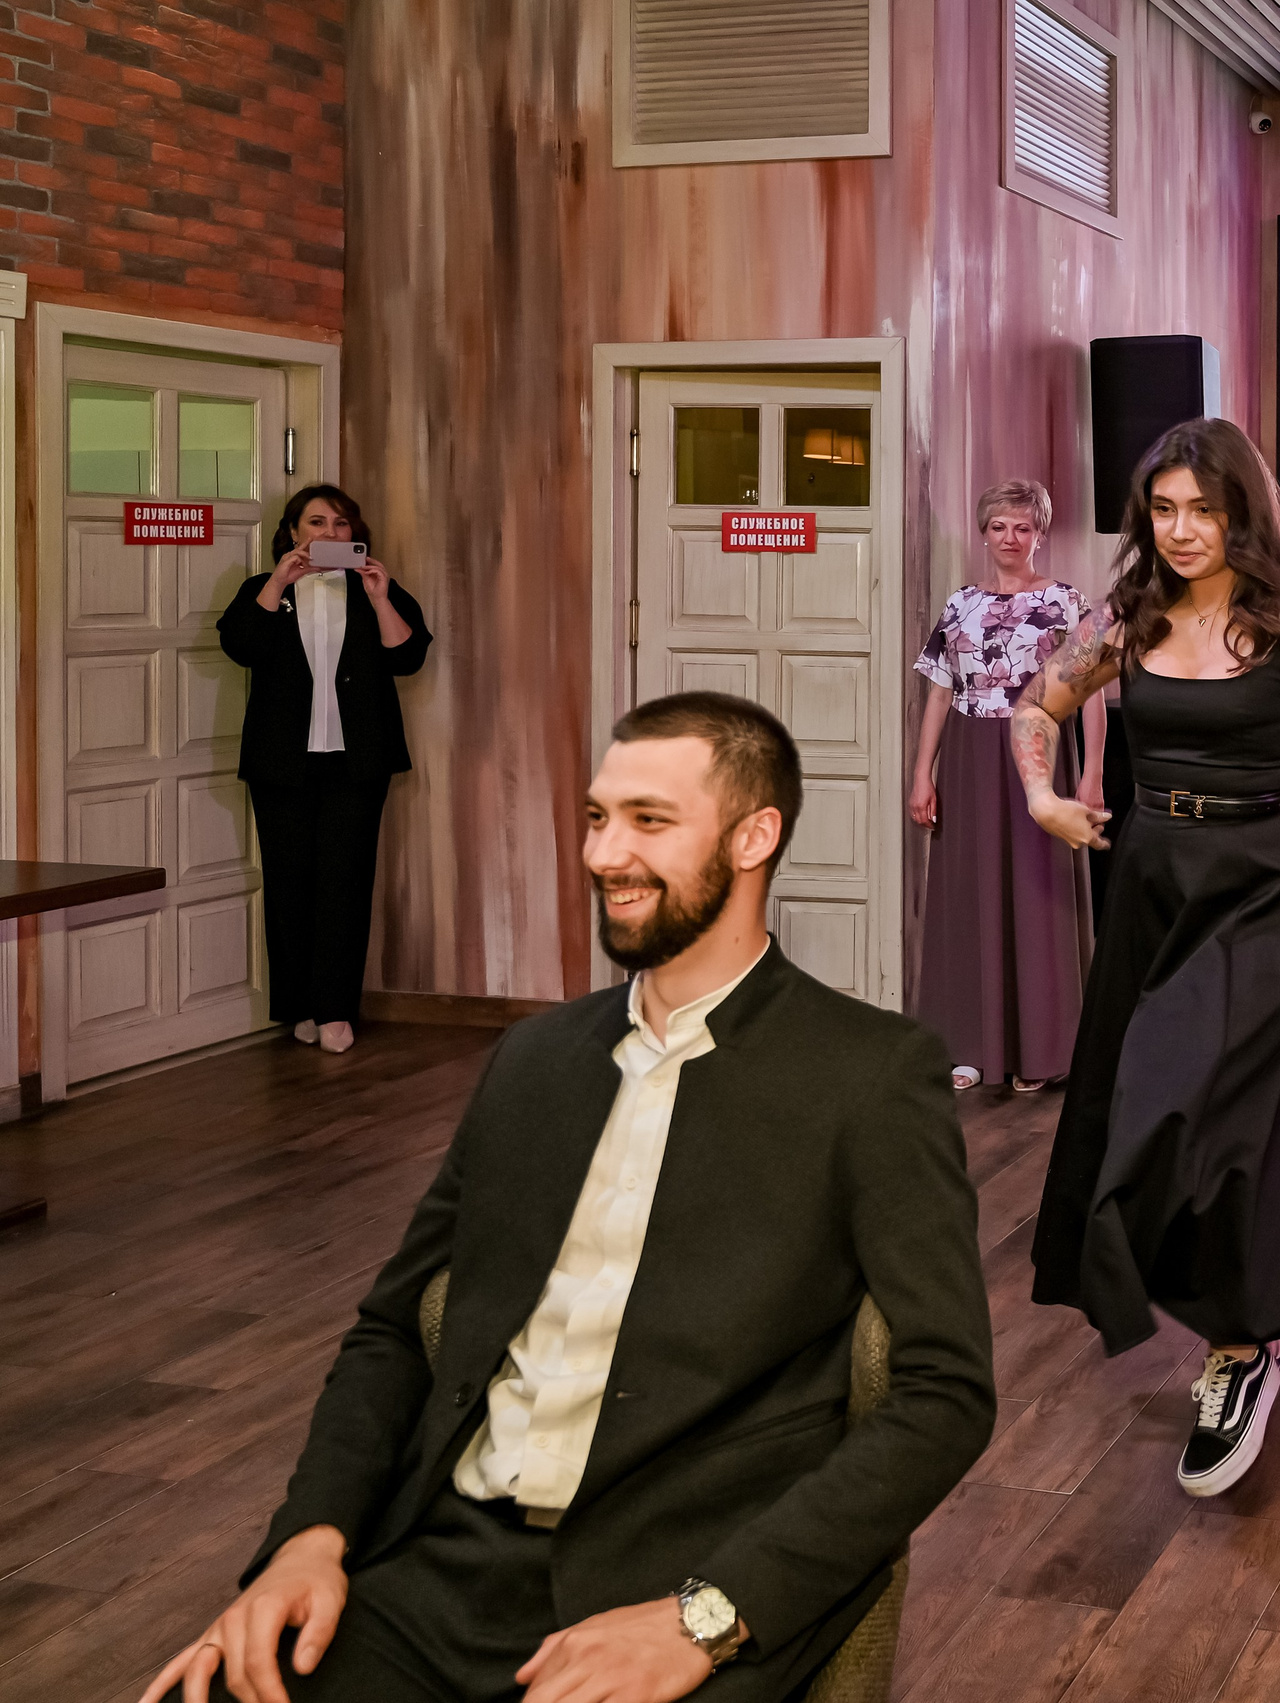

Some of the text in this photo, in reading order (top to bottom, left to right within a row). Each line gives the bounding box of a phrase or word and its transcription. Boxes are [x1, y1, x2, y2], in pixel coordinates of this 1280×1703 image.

[134, 507, 204, 521] СЛУЖЕБНОЕ
[731, 517, 805, 530] СЛУЖЕБНОЕ
[133, 525, 205, 539] ПОМЕЩЕНИЕ
[730, 533, 806, 548] ПОМЕЩЕНИЕ
